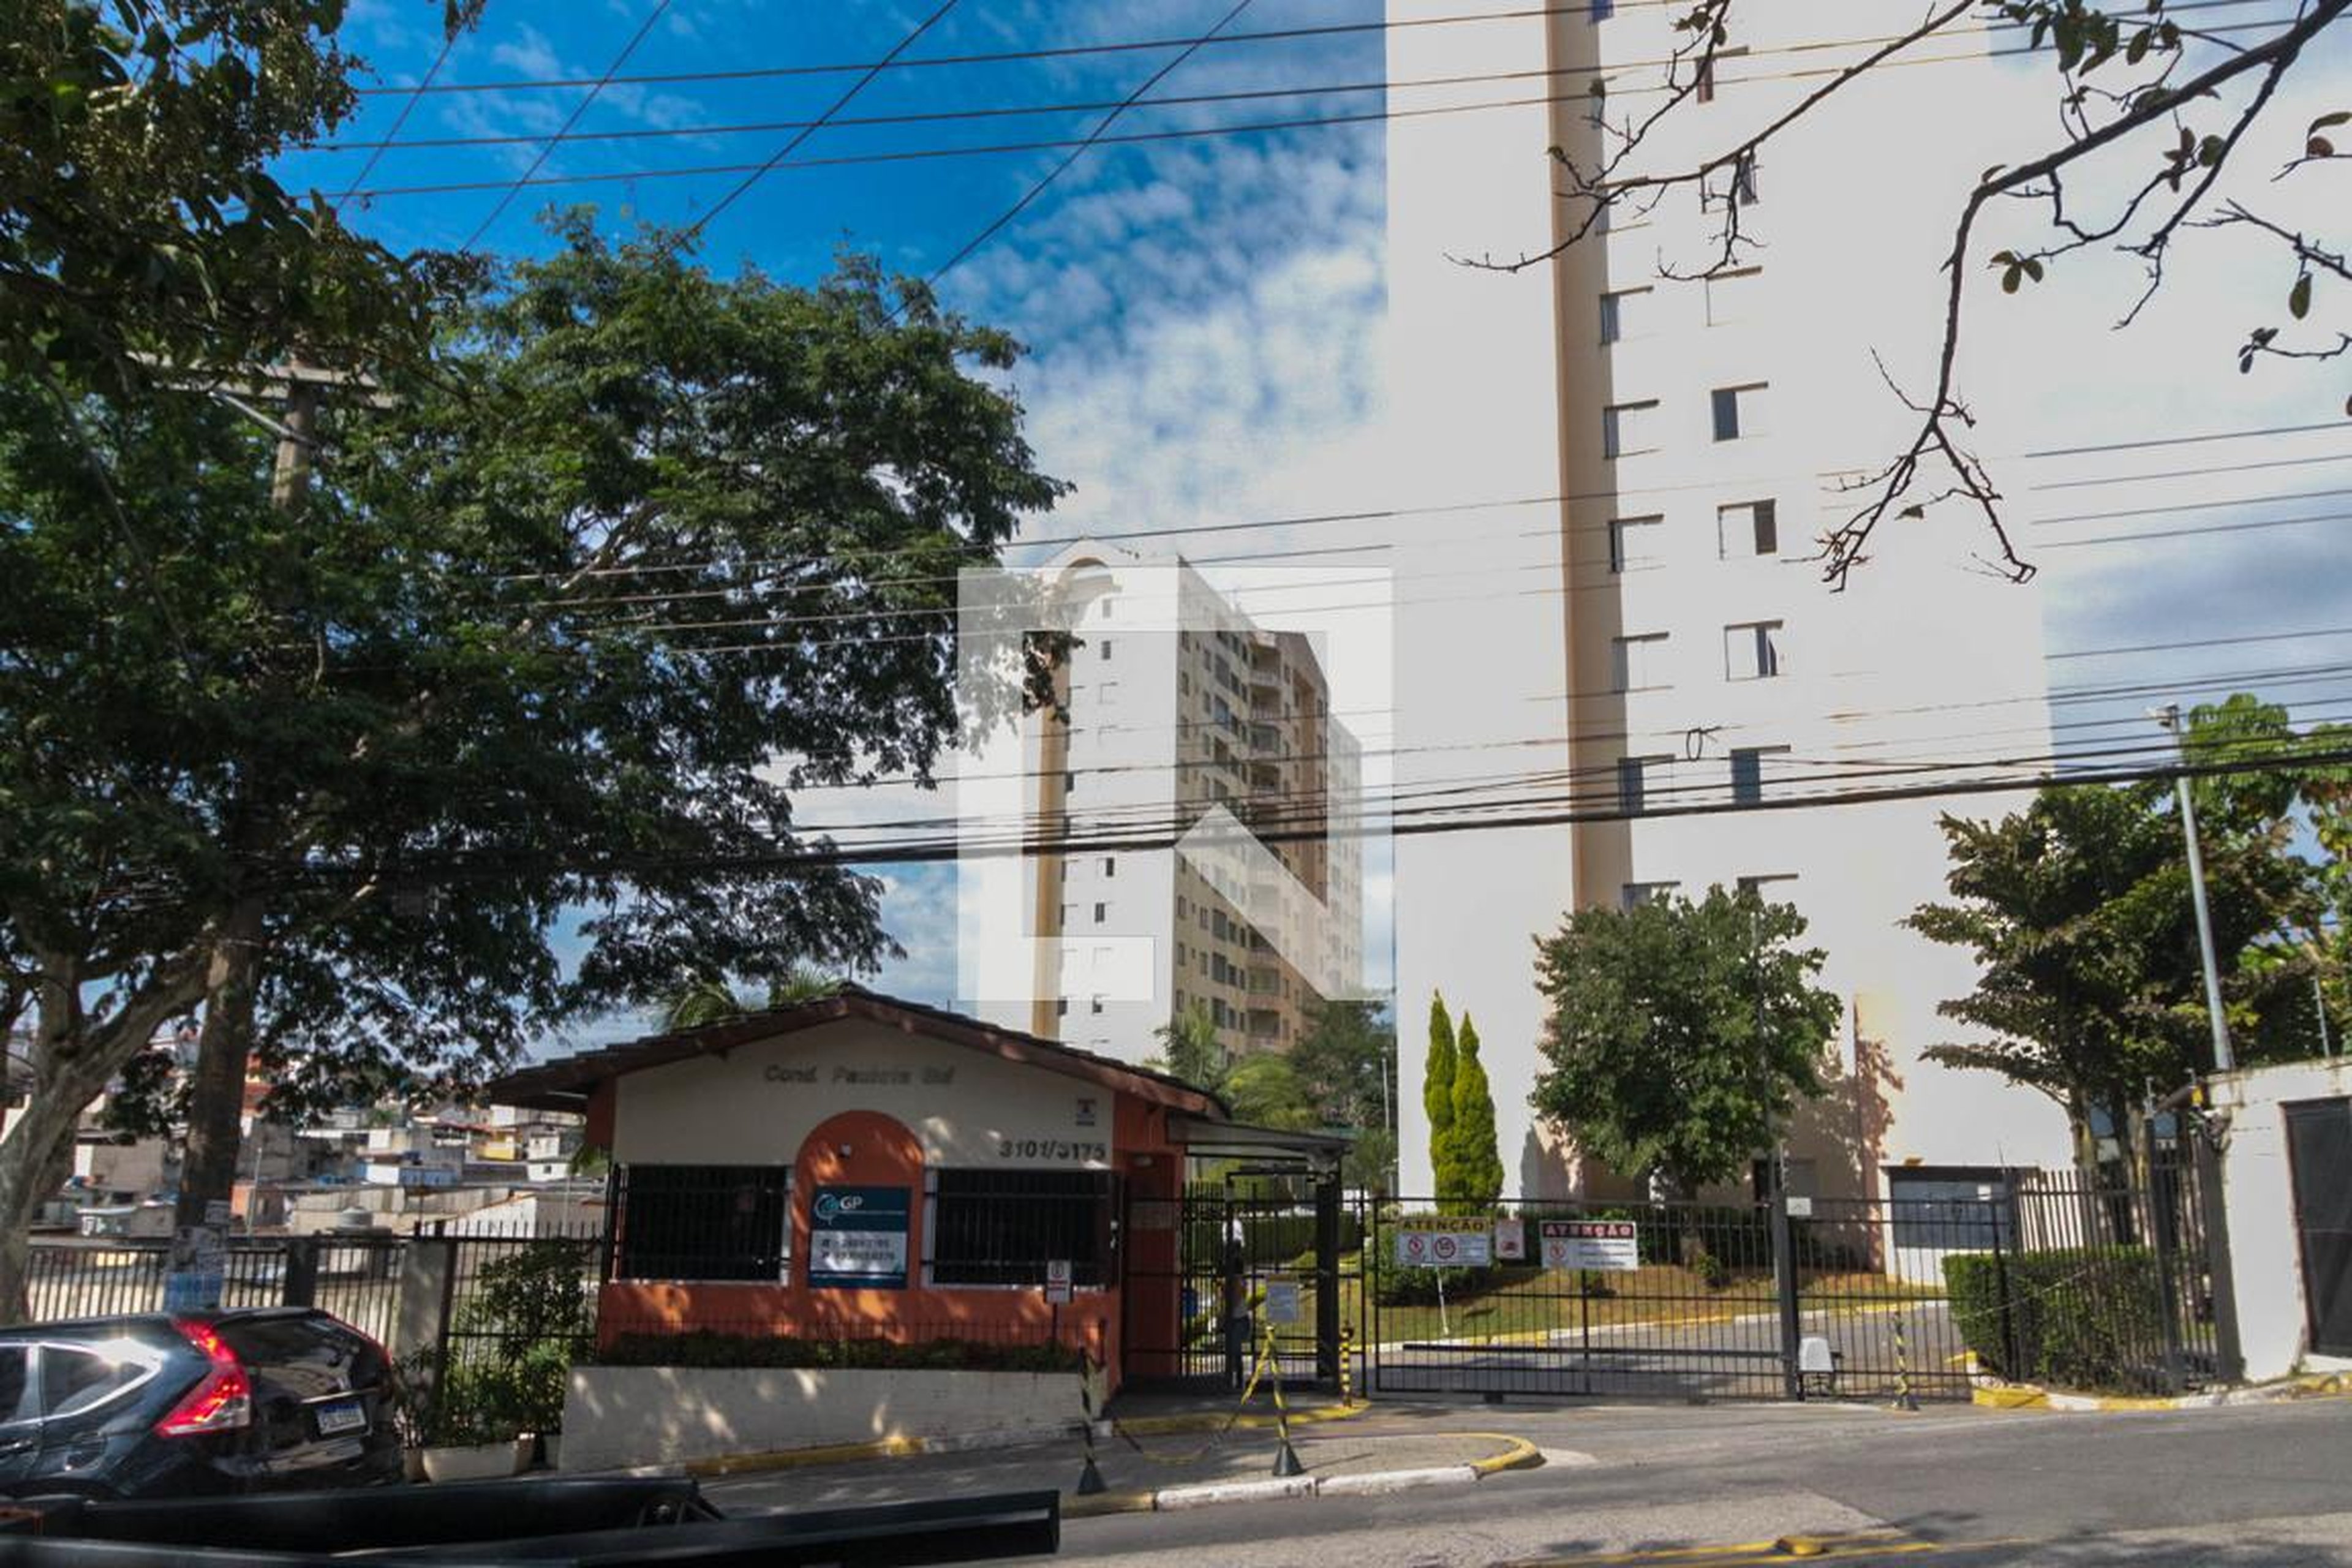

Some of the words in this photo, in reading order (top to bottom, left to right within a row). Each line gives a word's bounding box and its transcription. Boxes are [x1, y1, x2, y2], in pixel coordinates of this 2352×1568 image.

[840, 1196, 863, 1210] GP
[1403, 1219, 1484, 1232] ATENÇÃO
[1545, 1224, 1632, 1237] ATENÇÃO
